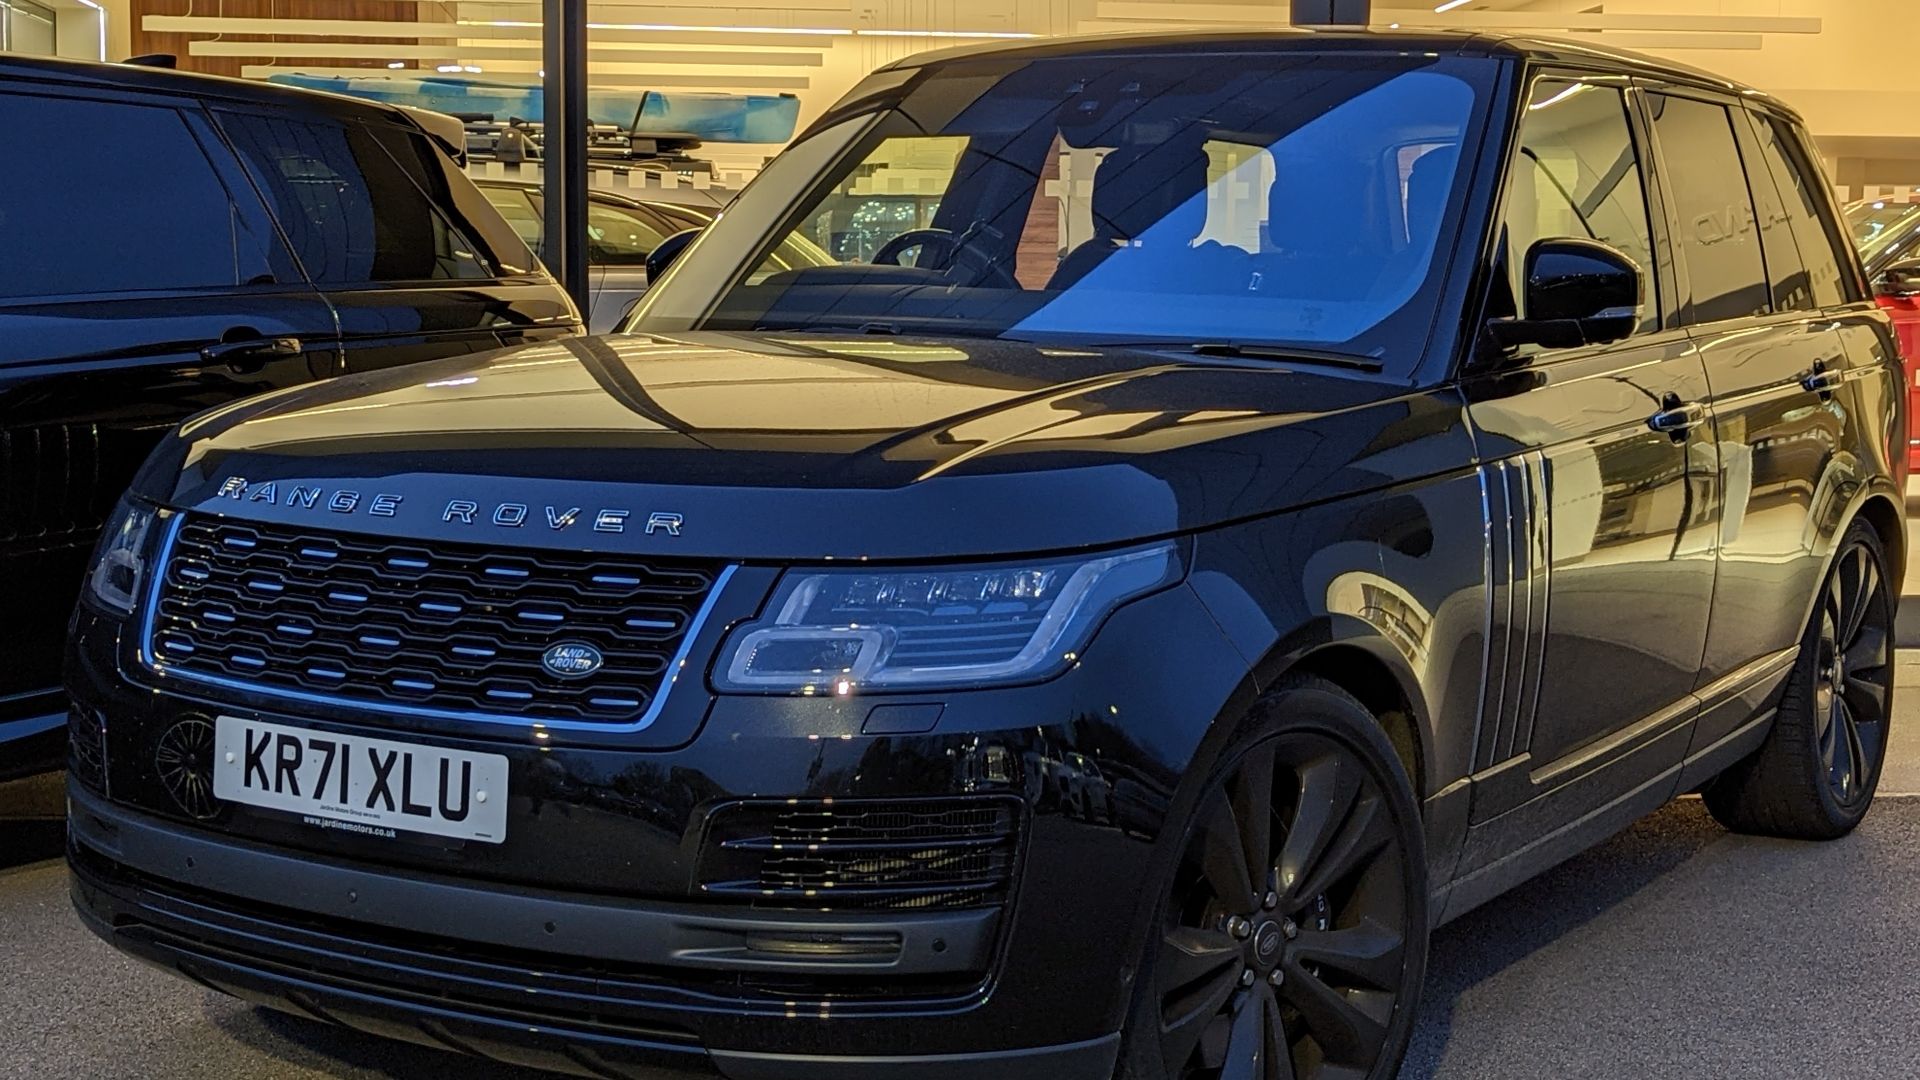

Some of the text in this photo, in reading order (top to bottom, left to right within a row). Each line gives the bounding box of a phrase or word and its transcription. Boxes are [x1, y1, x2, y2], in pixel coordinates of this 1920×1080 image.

[218, 476, 685, 537] RANGE ROVER
[553, 657, 592, 670] ROVER
[554, 647, 585, 658] LAND
[243, 728, 472, 822] KR71 XLU
[303, 815, 397, 838] www.jardinemotors.co.uk
